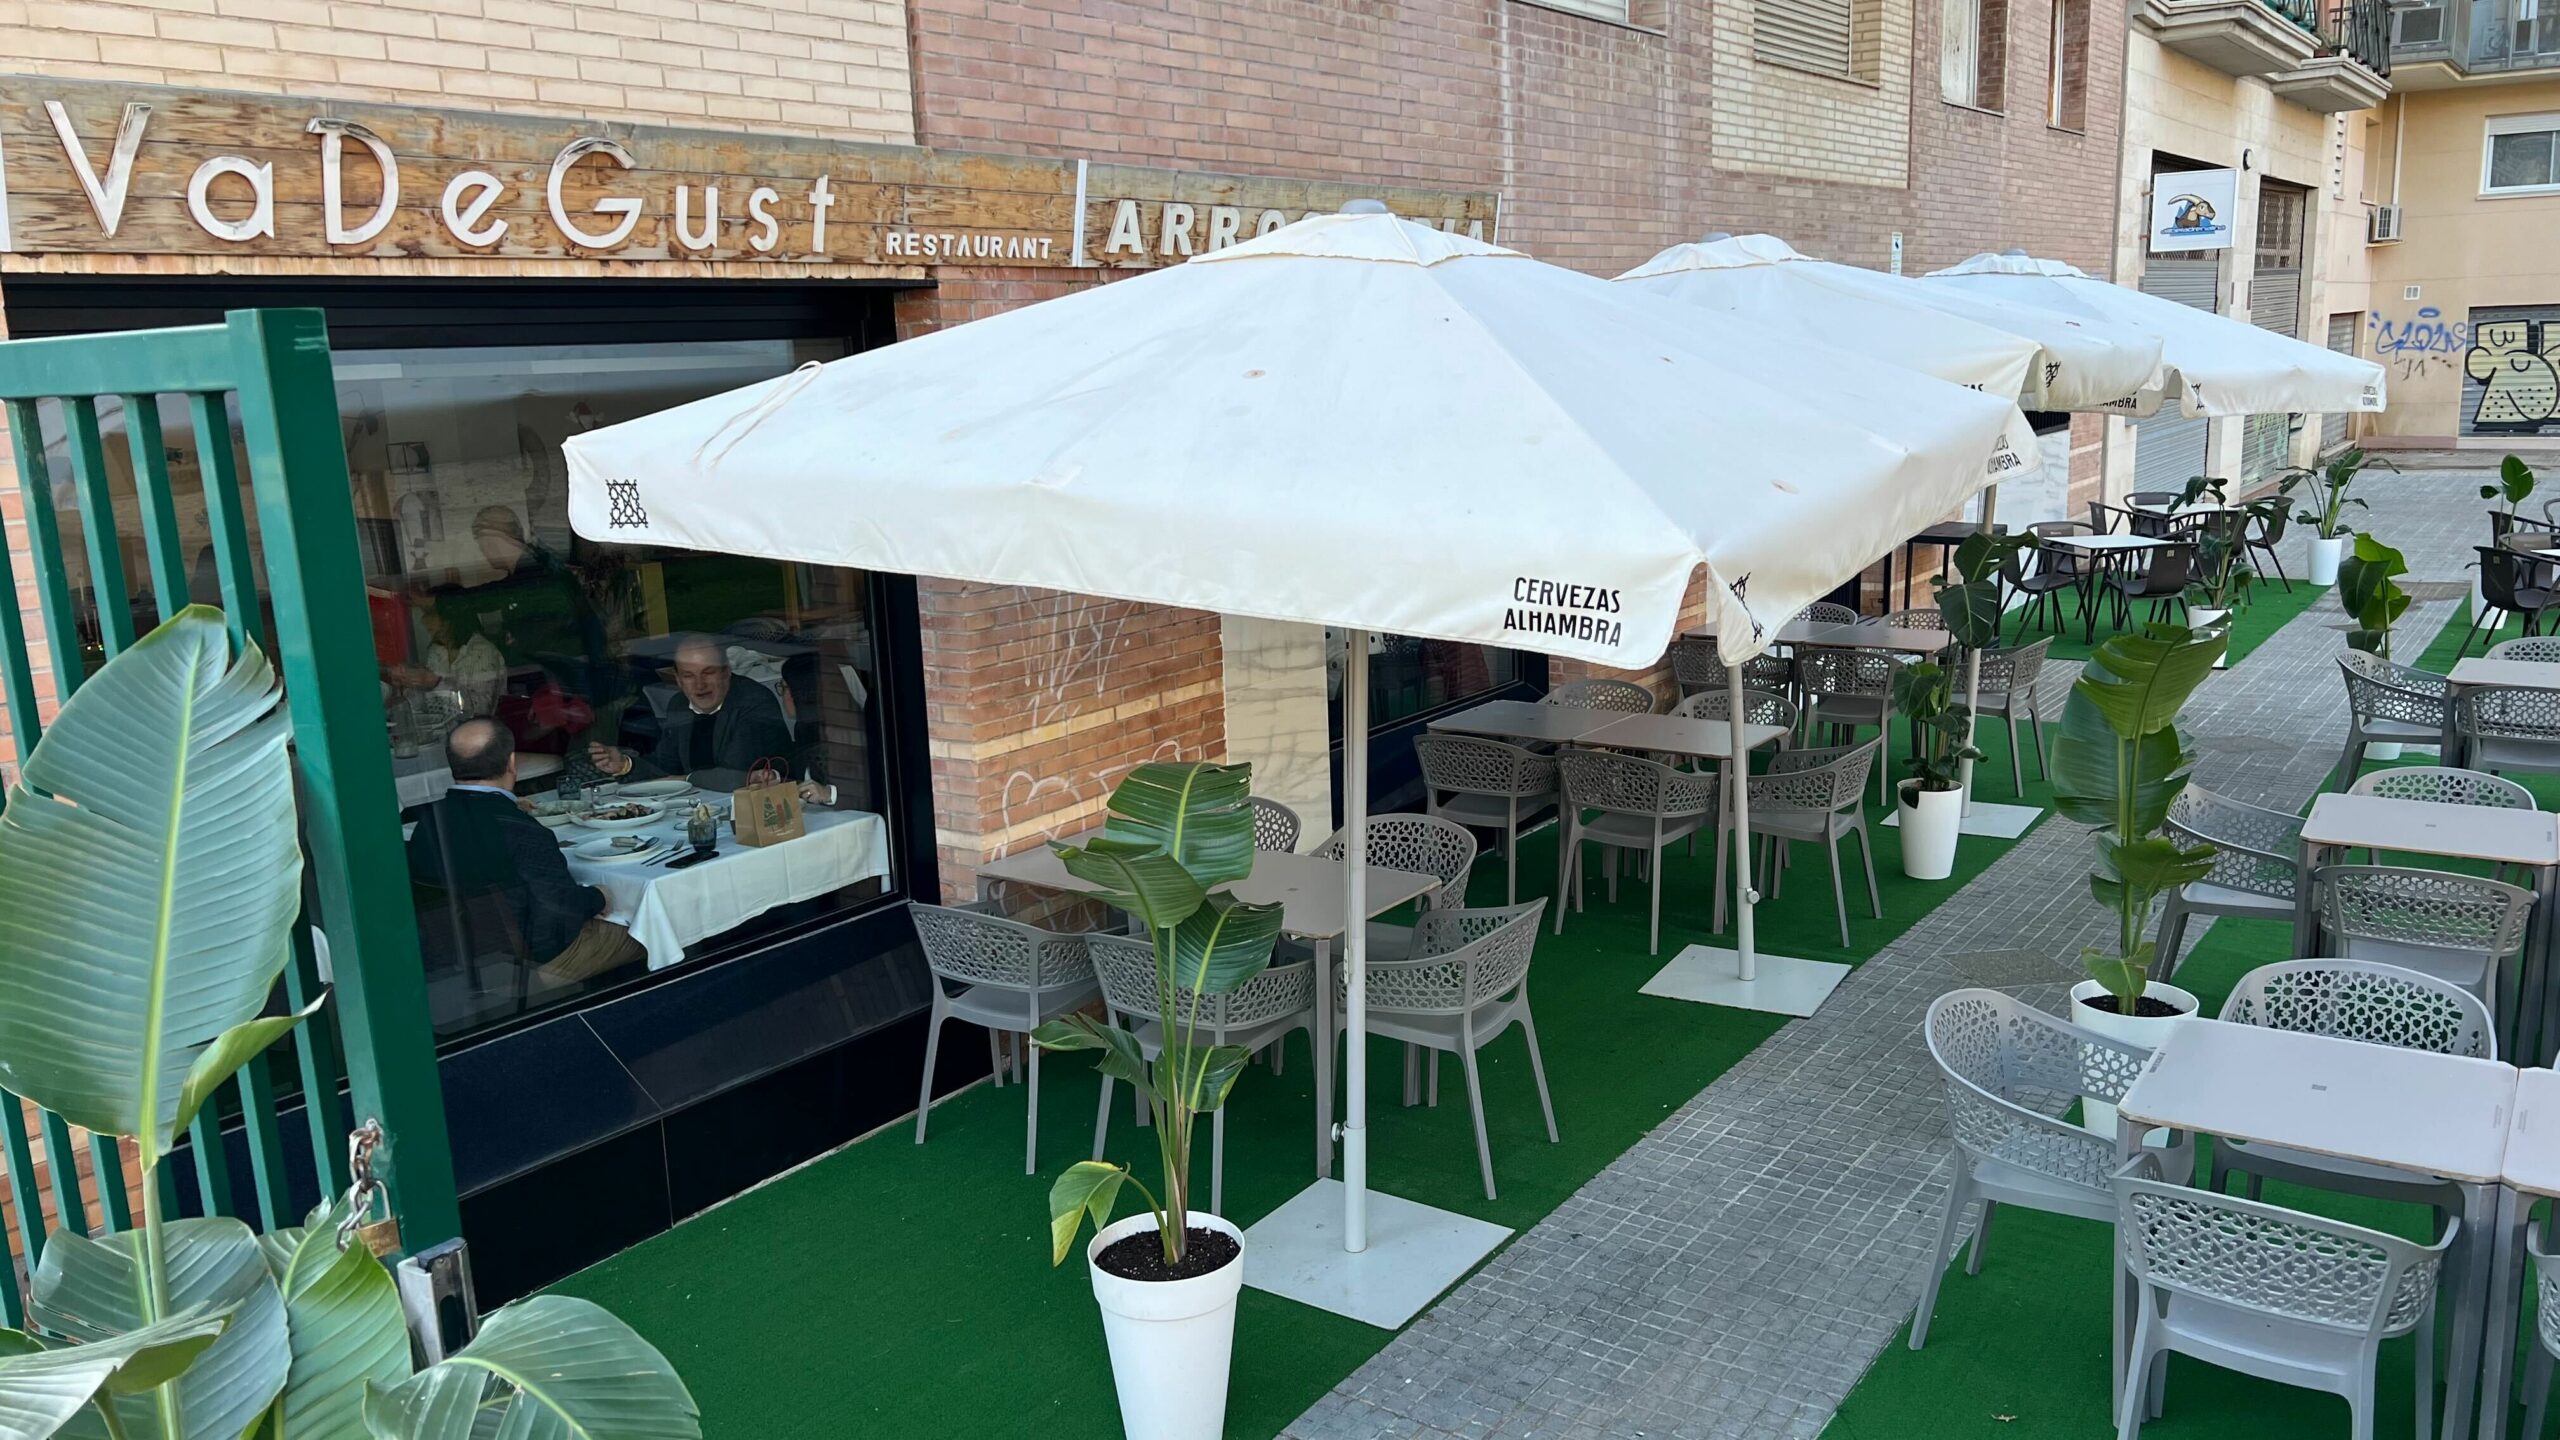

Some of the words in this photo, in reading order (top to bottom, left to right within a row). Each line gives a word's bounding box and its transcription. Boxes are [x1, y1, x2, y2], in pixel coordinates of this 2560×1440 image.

[885, 231, 1053, 260] RESTAURANT
[1513, 576, 1621, 614] CERVEZAS
[1503, 607, 1622, 647] ALHAMBRA
